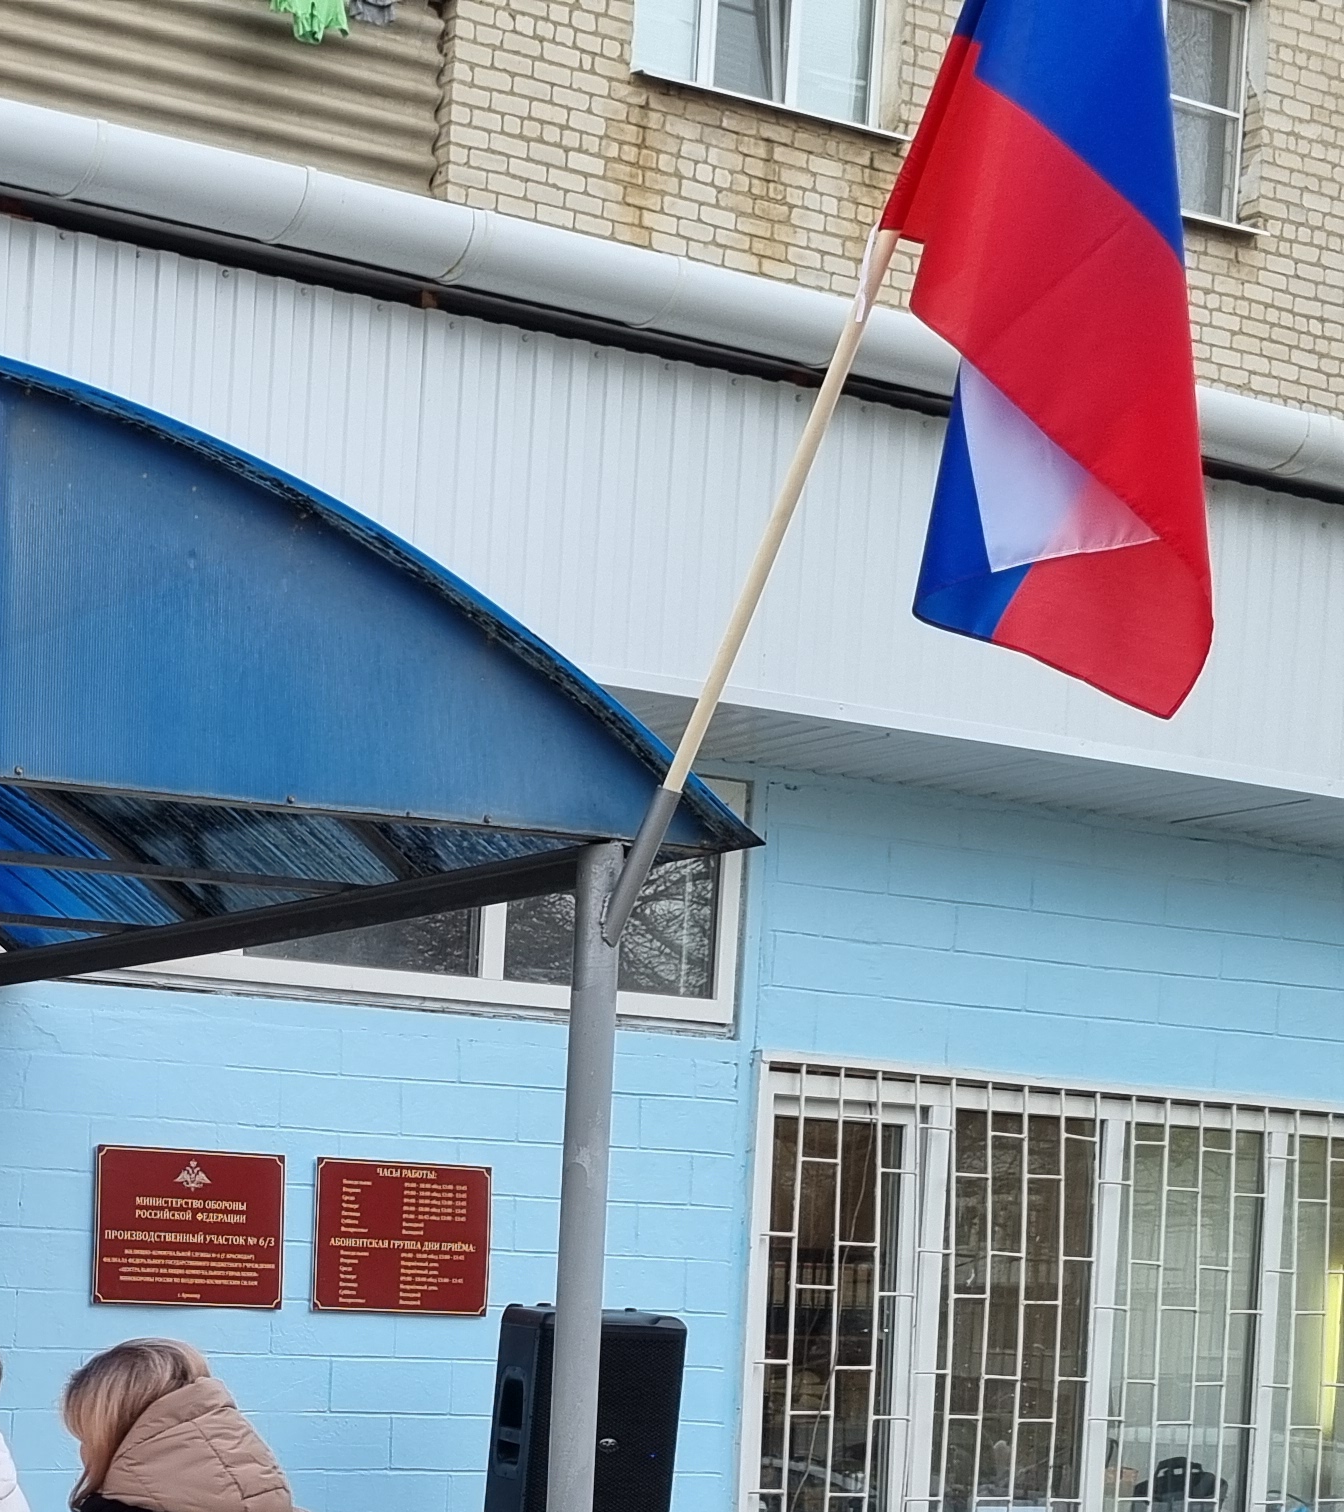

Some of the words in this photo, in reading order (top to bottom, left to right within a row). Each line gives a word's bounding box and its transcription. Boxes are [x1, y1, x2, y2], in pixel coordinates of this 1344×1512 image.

[377, 1168, 400, 1177] ЧАСЫ
[135, 1196, 203, 1209] МИНИСТЕРСТВО
[205, 1200, 247, 1211] ОБОРОНЫ
[135, 1209, 192, 1221] РОССИЙСКОЙ
[196, 1212, 247, 1224] ФЕДЕРАЦИИ
[104, 1229, 204, 1244] ПРОИЗВОДСТВЕННЫЙ
[206, 1235, 246, 1246] УЧАСТОК
[258, 1236, 275, 1249] 6/3
[329, 1237, 389, 1248] АБОНЕНТСКАЯ
[390, 1241, 421, 1250] ГРУППА
